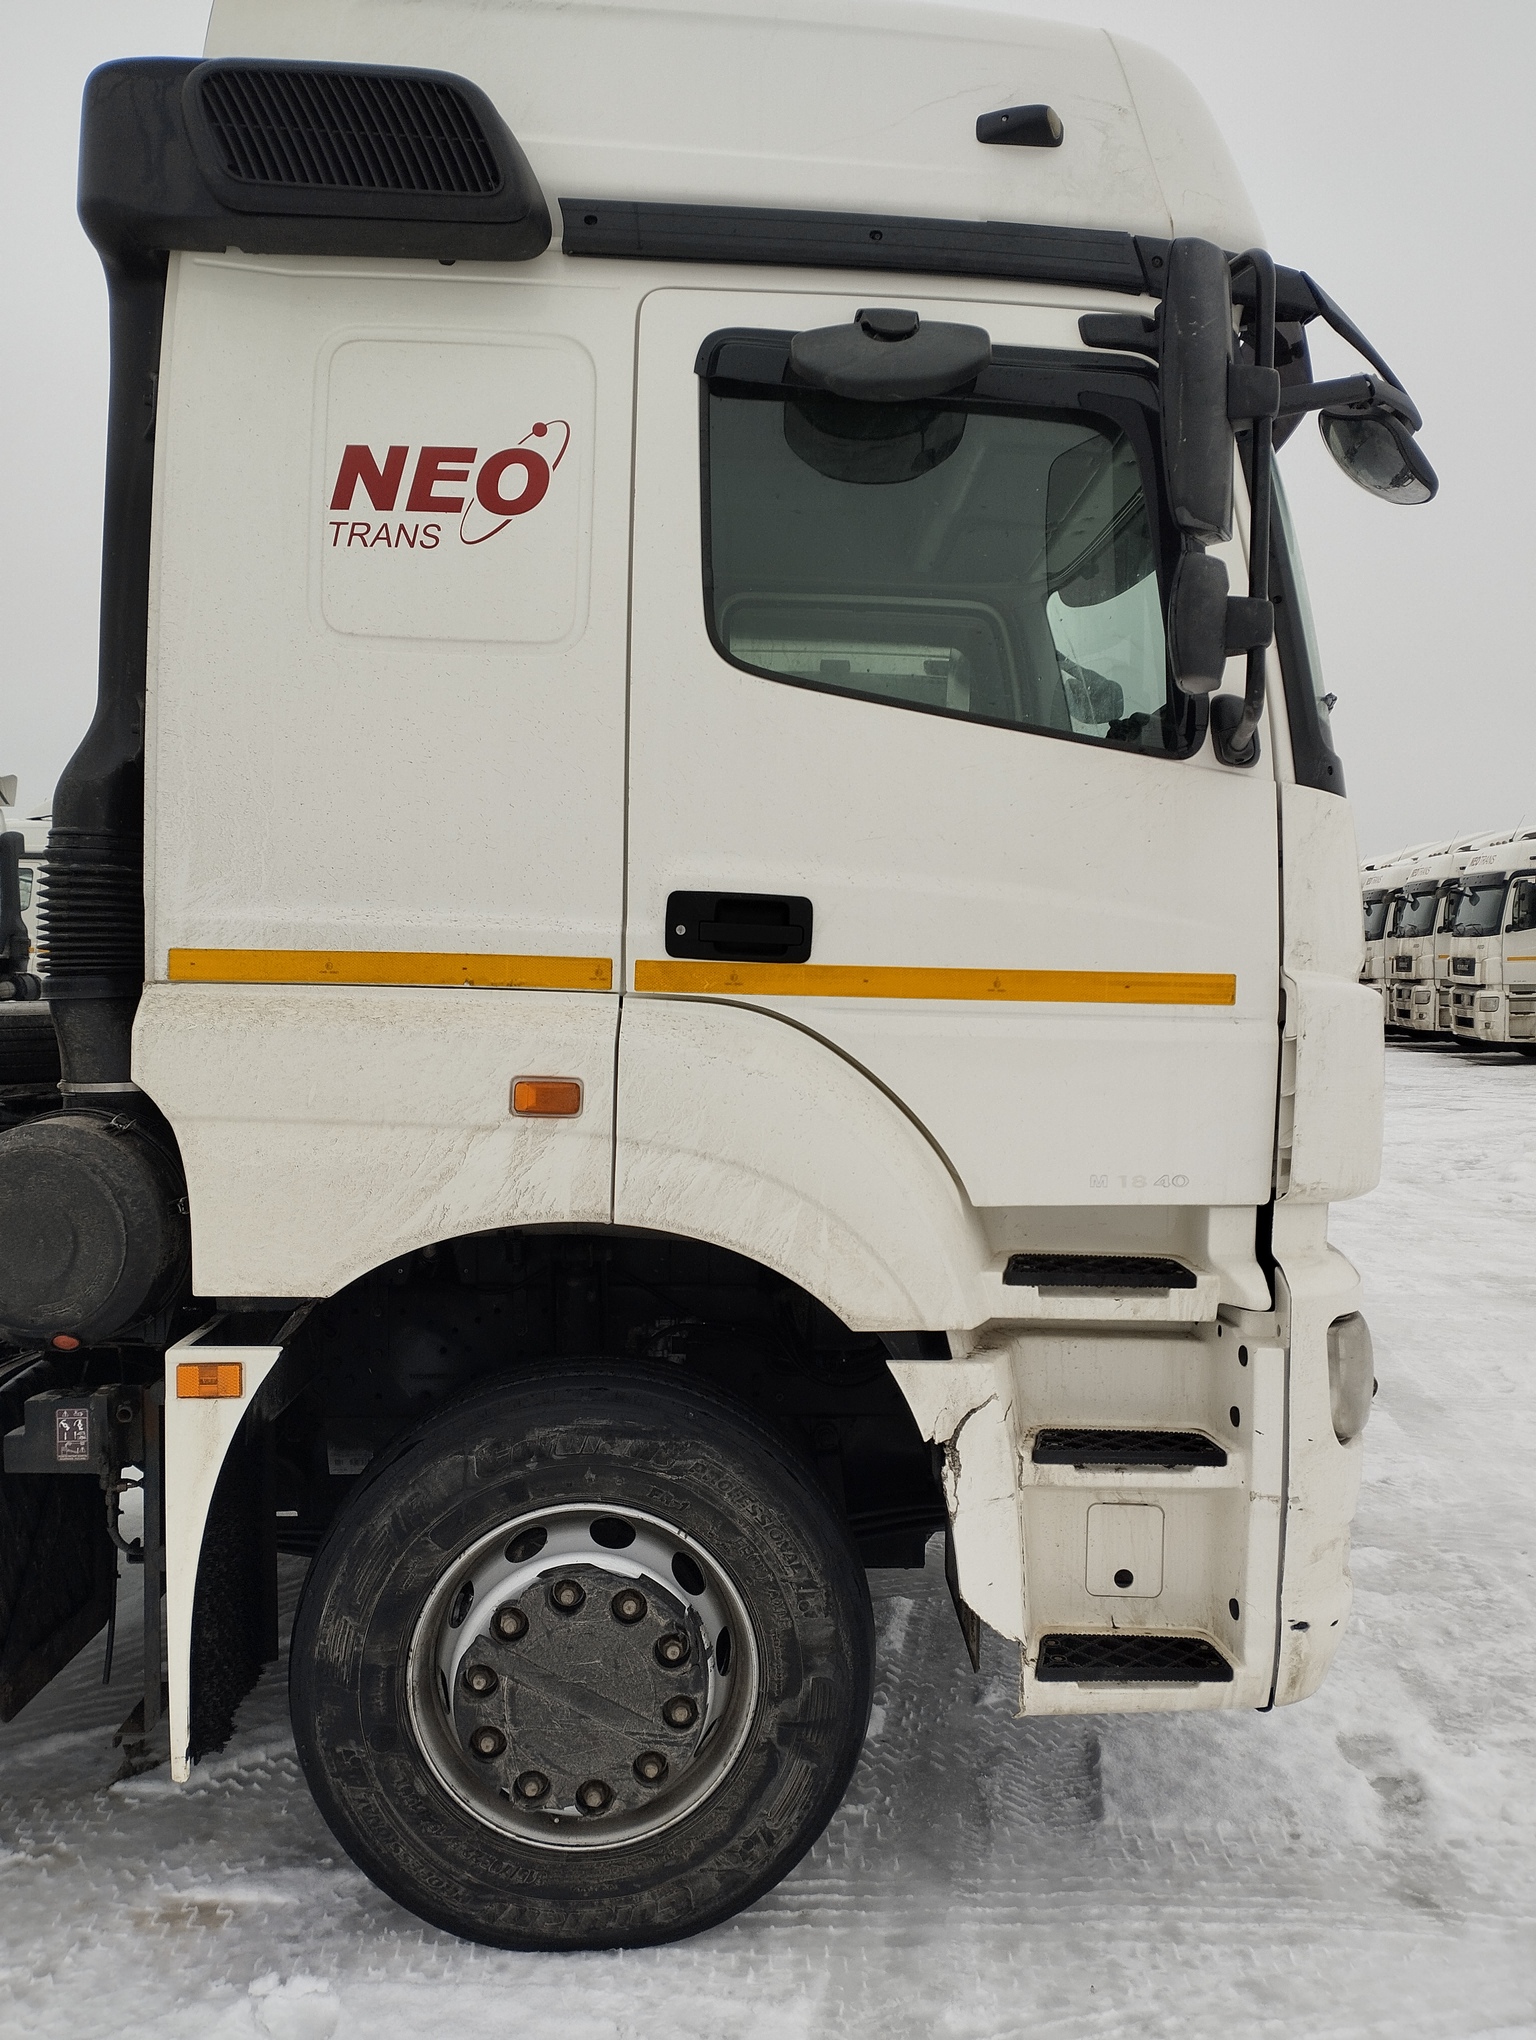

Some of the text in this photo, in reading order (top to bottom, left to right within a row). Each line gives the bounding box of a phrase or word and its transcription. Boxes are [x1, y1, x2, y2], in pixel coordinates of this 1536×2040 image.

[330, 444, 550, 516] NEO
[329, 521, 442, 549] TRANS
[1089, 1174, 1190, 1188] M 18 40
[688, 1461, 806, 1576] PROFESSIONAL
